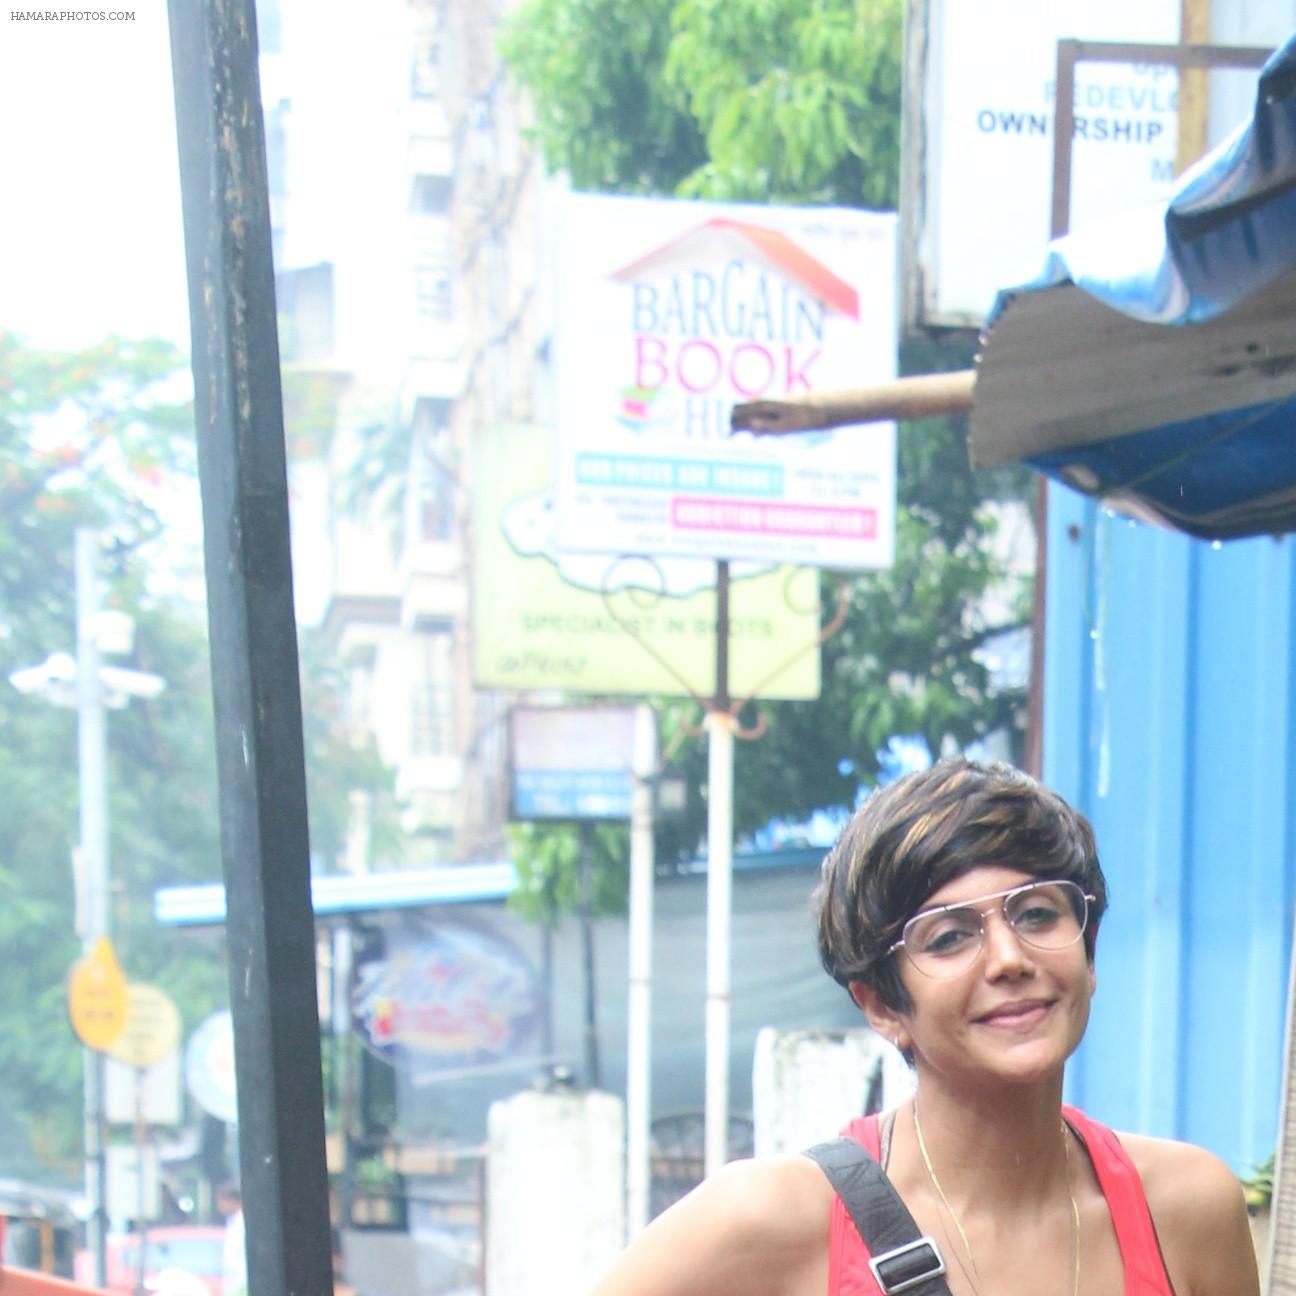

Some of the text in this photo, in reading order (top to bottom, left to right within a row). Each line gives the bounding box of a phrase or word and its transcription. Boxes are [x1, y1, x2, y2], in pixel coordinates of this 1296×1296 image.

[977, 109, 1164, 144] OWNRSHIP
[631, 258, 827, 342] BARGAIN
[633, 336, 821, 398] BOOK
[684, 396, 736, 440] HU
